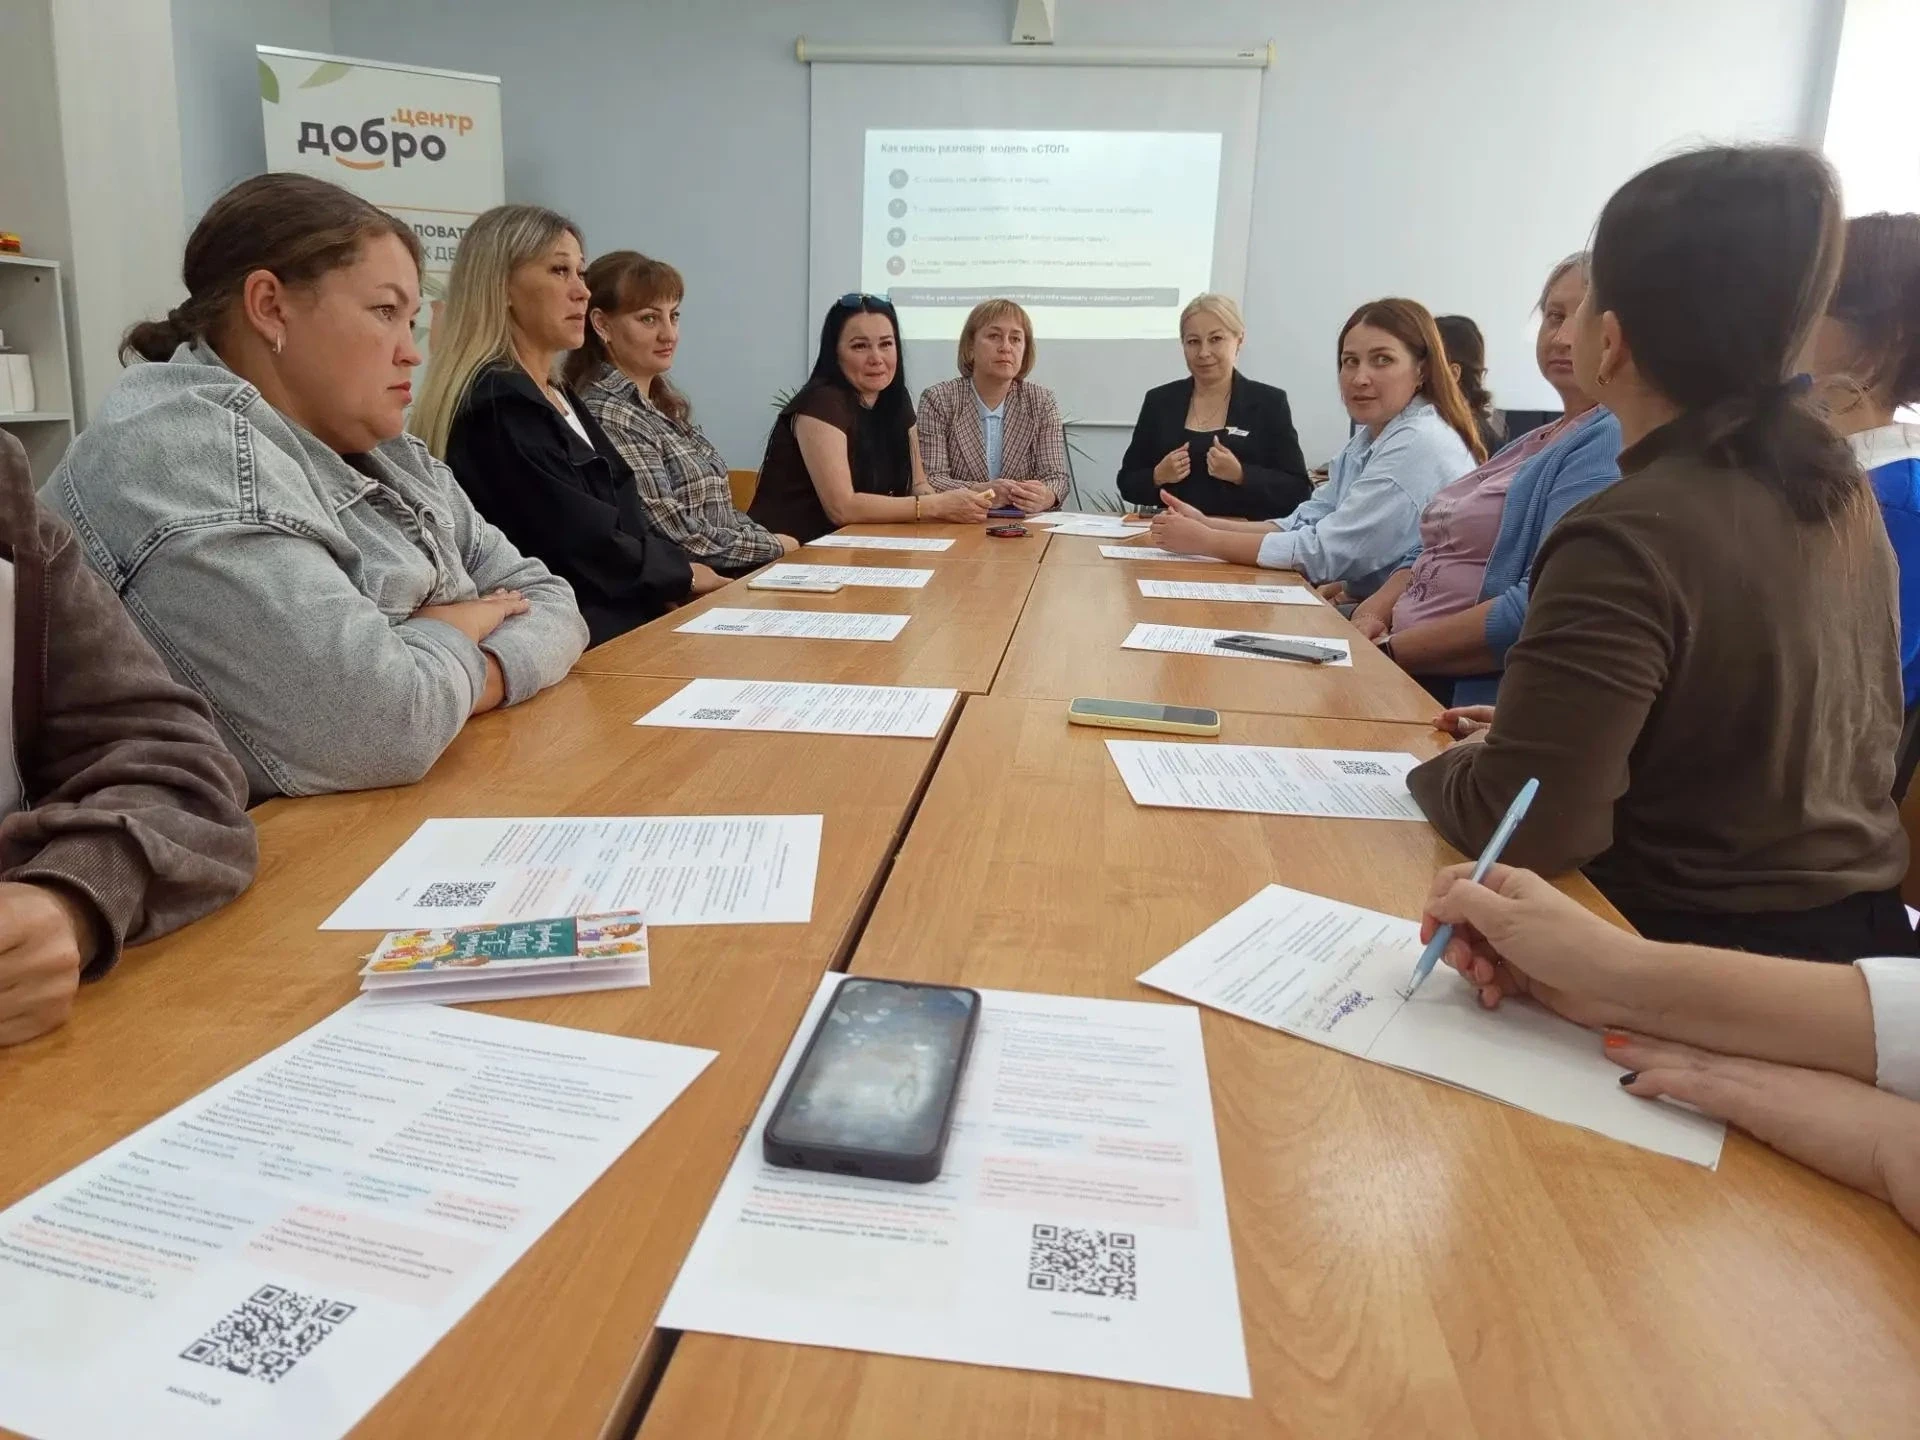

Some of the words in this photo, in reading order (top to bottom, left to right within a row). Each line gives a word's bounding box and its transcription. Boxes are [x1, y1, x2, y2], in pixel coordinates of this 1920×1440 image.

[298, 117, 447, 168] добро
[881, 143, 900, 153] Как
[901, 143, 936, 153] начать
